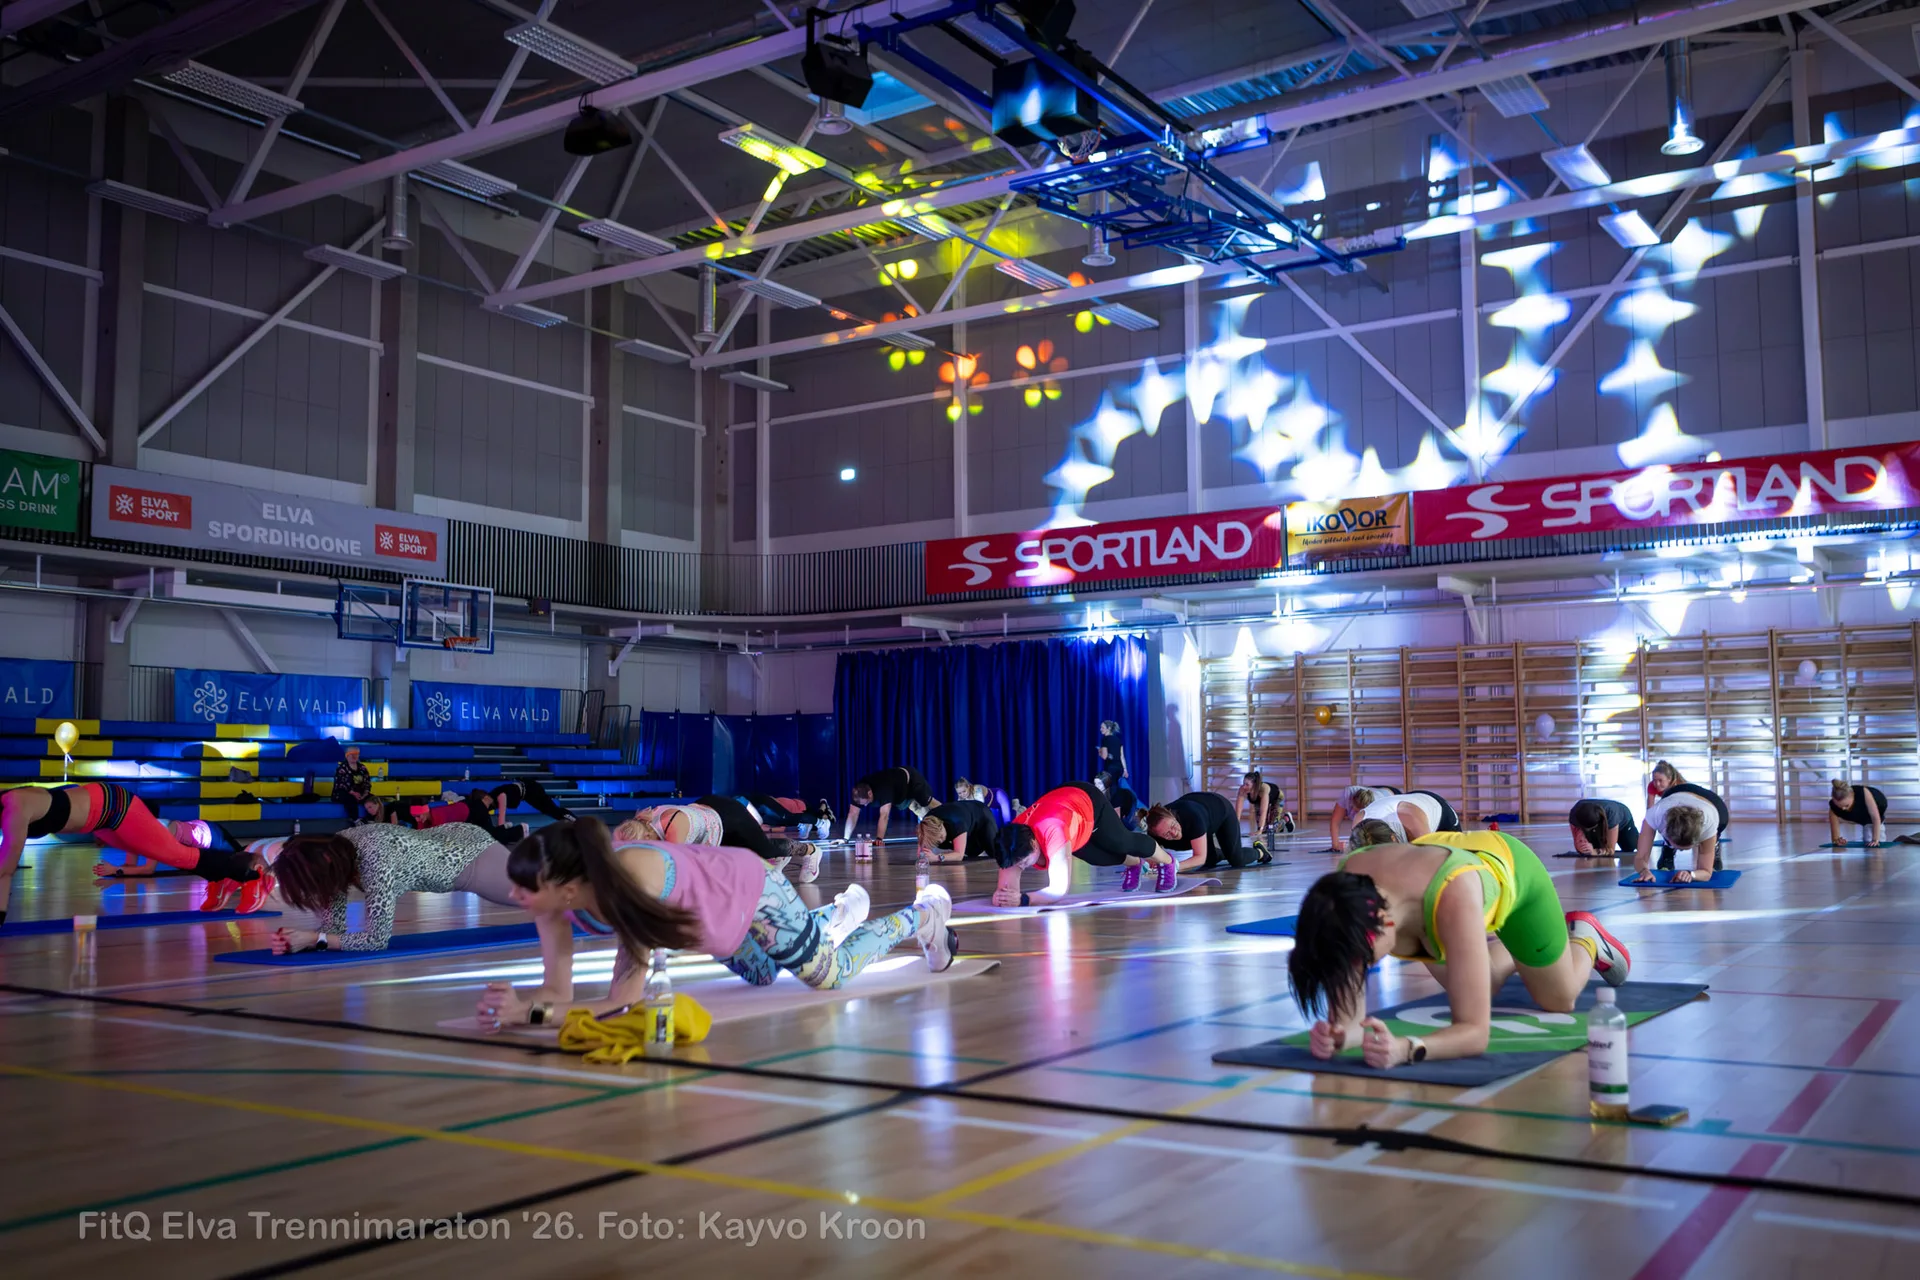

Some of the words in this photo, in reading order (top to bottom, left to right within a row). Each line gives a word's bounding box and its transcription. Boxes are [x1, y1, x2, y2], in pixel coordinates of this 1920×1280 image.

[140, 496, 170, 510] ELVA
[1541, 456, 1885, 528] SPORTLAND
[19, 501, 57, 515] DRINK
[141, 507, 180, 522] SPORT
[262, 502, 315, 526] ELVA
[1305, 507, 1388, 534] IKODOR
[208, 520, 363, 557] SPORDIHOONE
[398, 533, 421, 545] ELVA
[398, 543, 428, 556] SPORT
[1015, 521, 1252, 577] SPORTLAND
[238, 692, 288, 712] ELVA
[299, 698, 348, 716] VALD
[461, 702, 501, 719] ELVA
[510, 708, 550, 722] VALD
